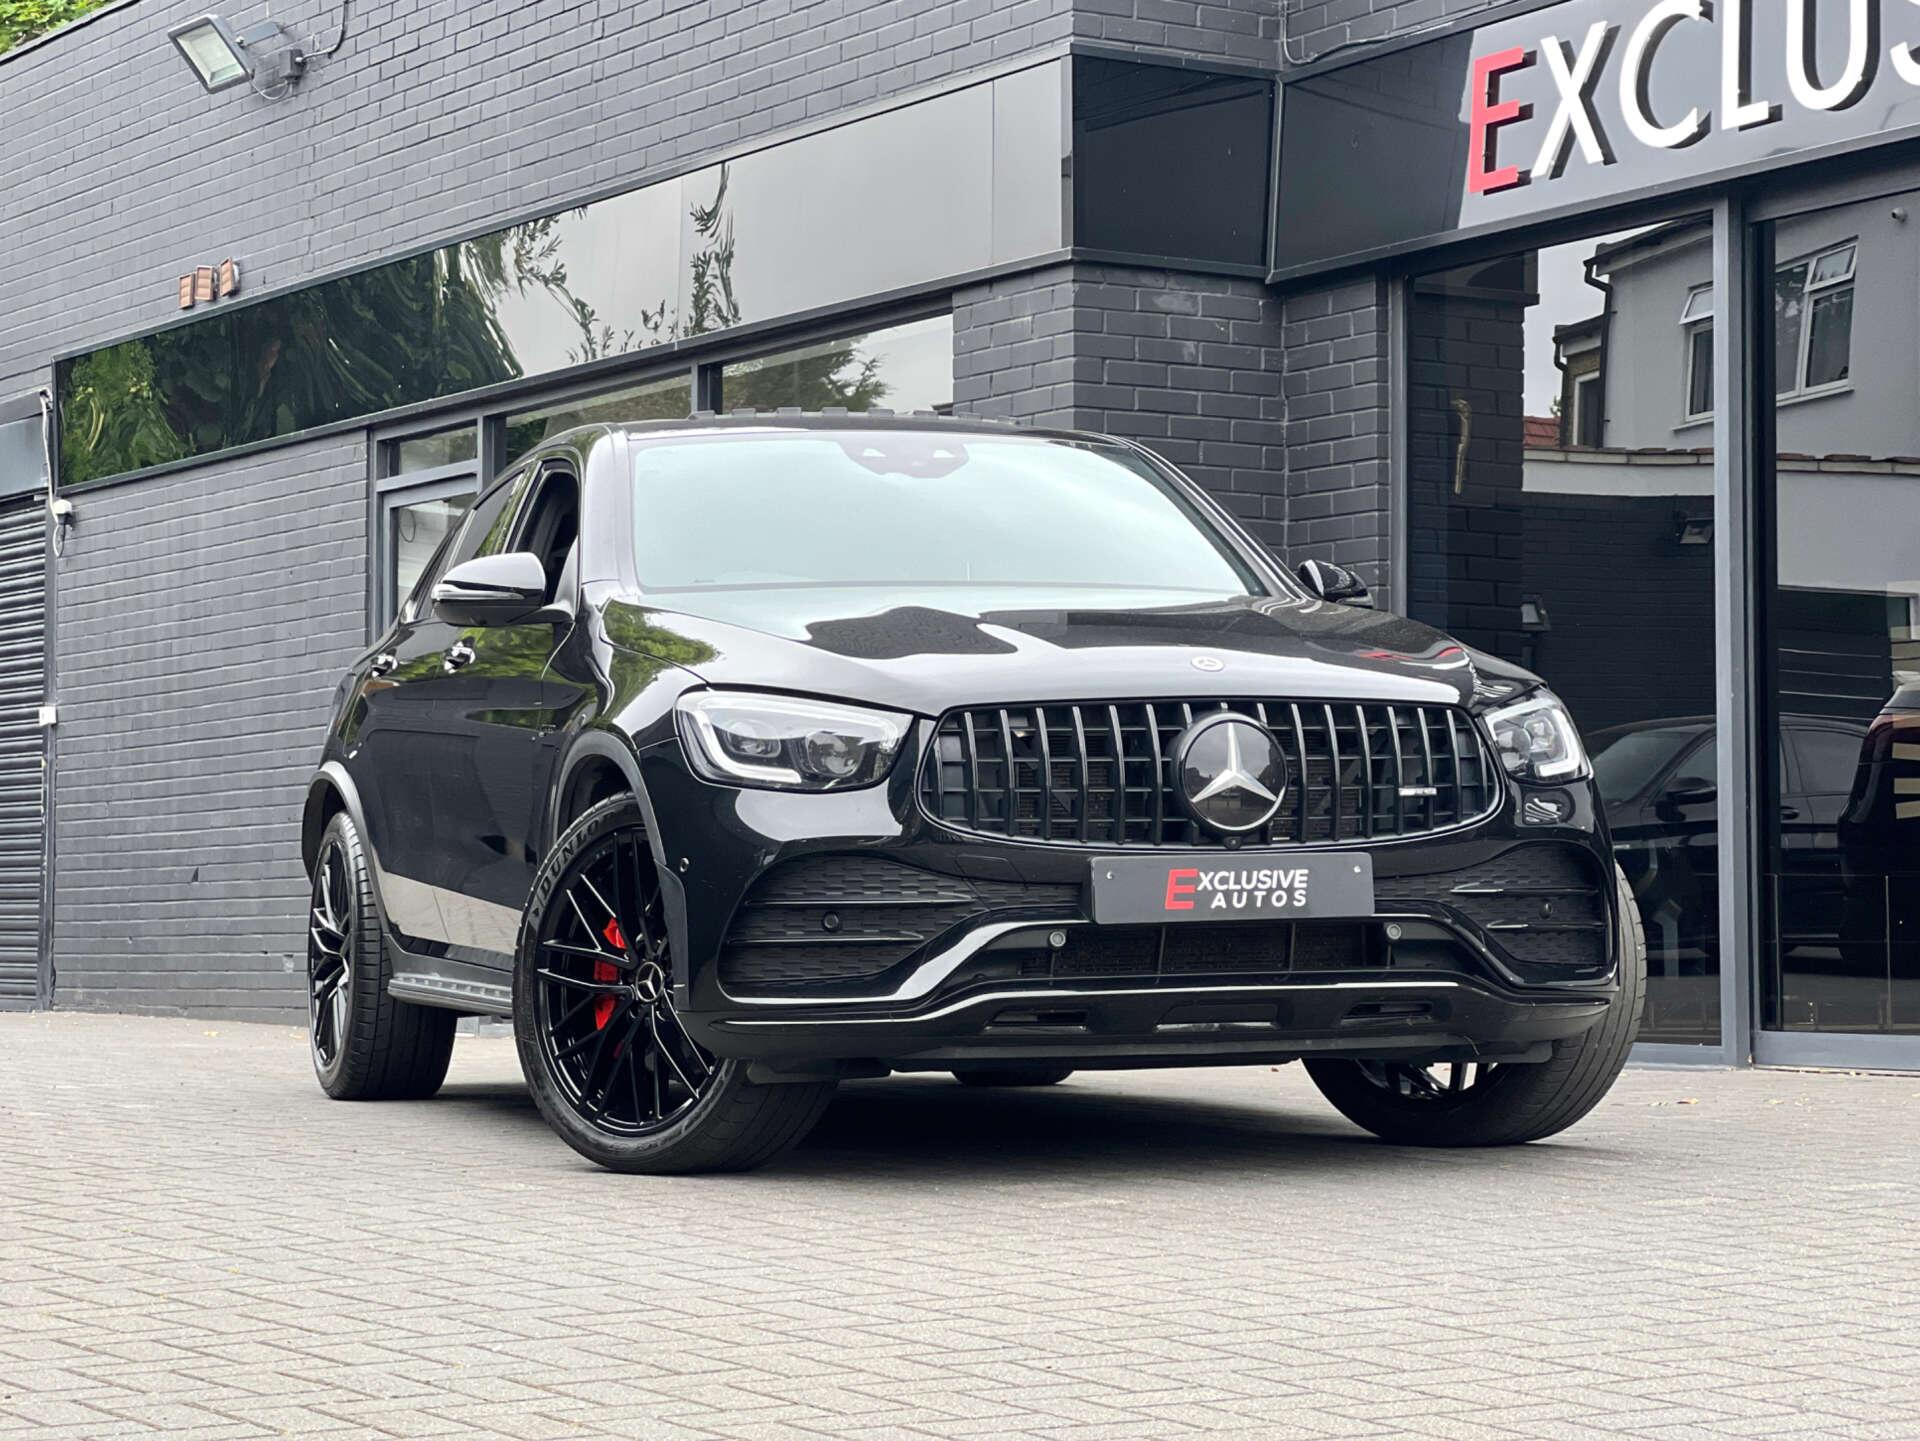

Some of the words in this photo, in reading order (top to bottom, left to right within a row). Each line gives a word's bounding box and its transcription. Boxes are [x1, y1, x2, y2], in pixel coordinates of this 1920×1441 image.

[1469, 0, 1920, 193] EXCLU
[1164, 868, 1309, 910] EXCLUSIVE
[1210, 889, 1307, 910] AUTOS
